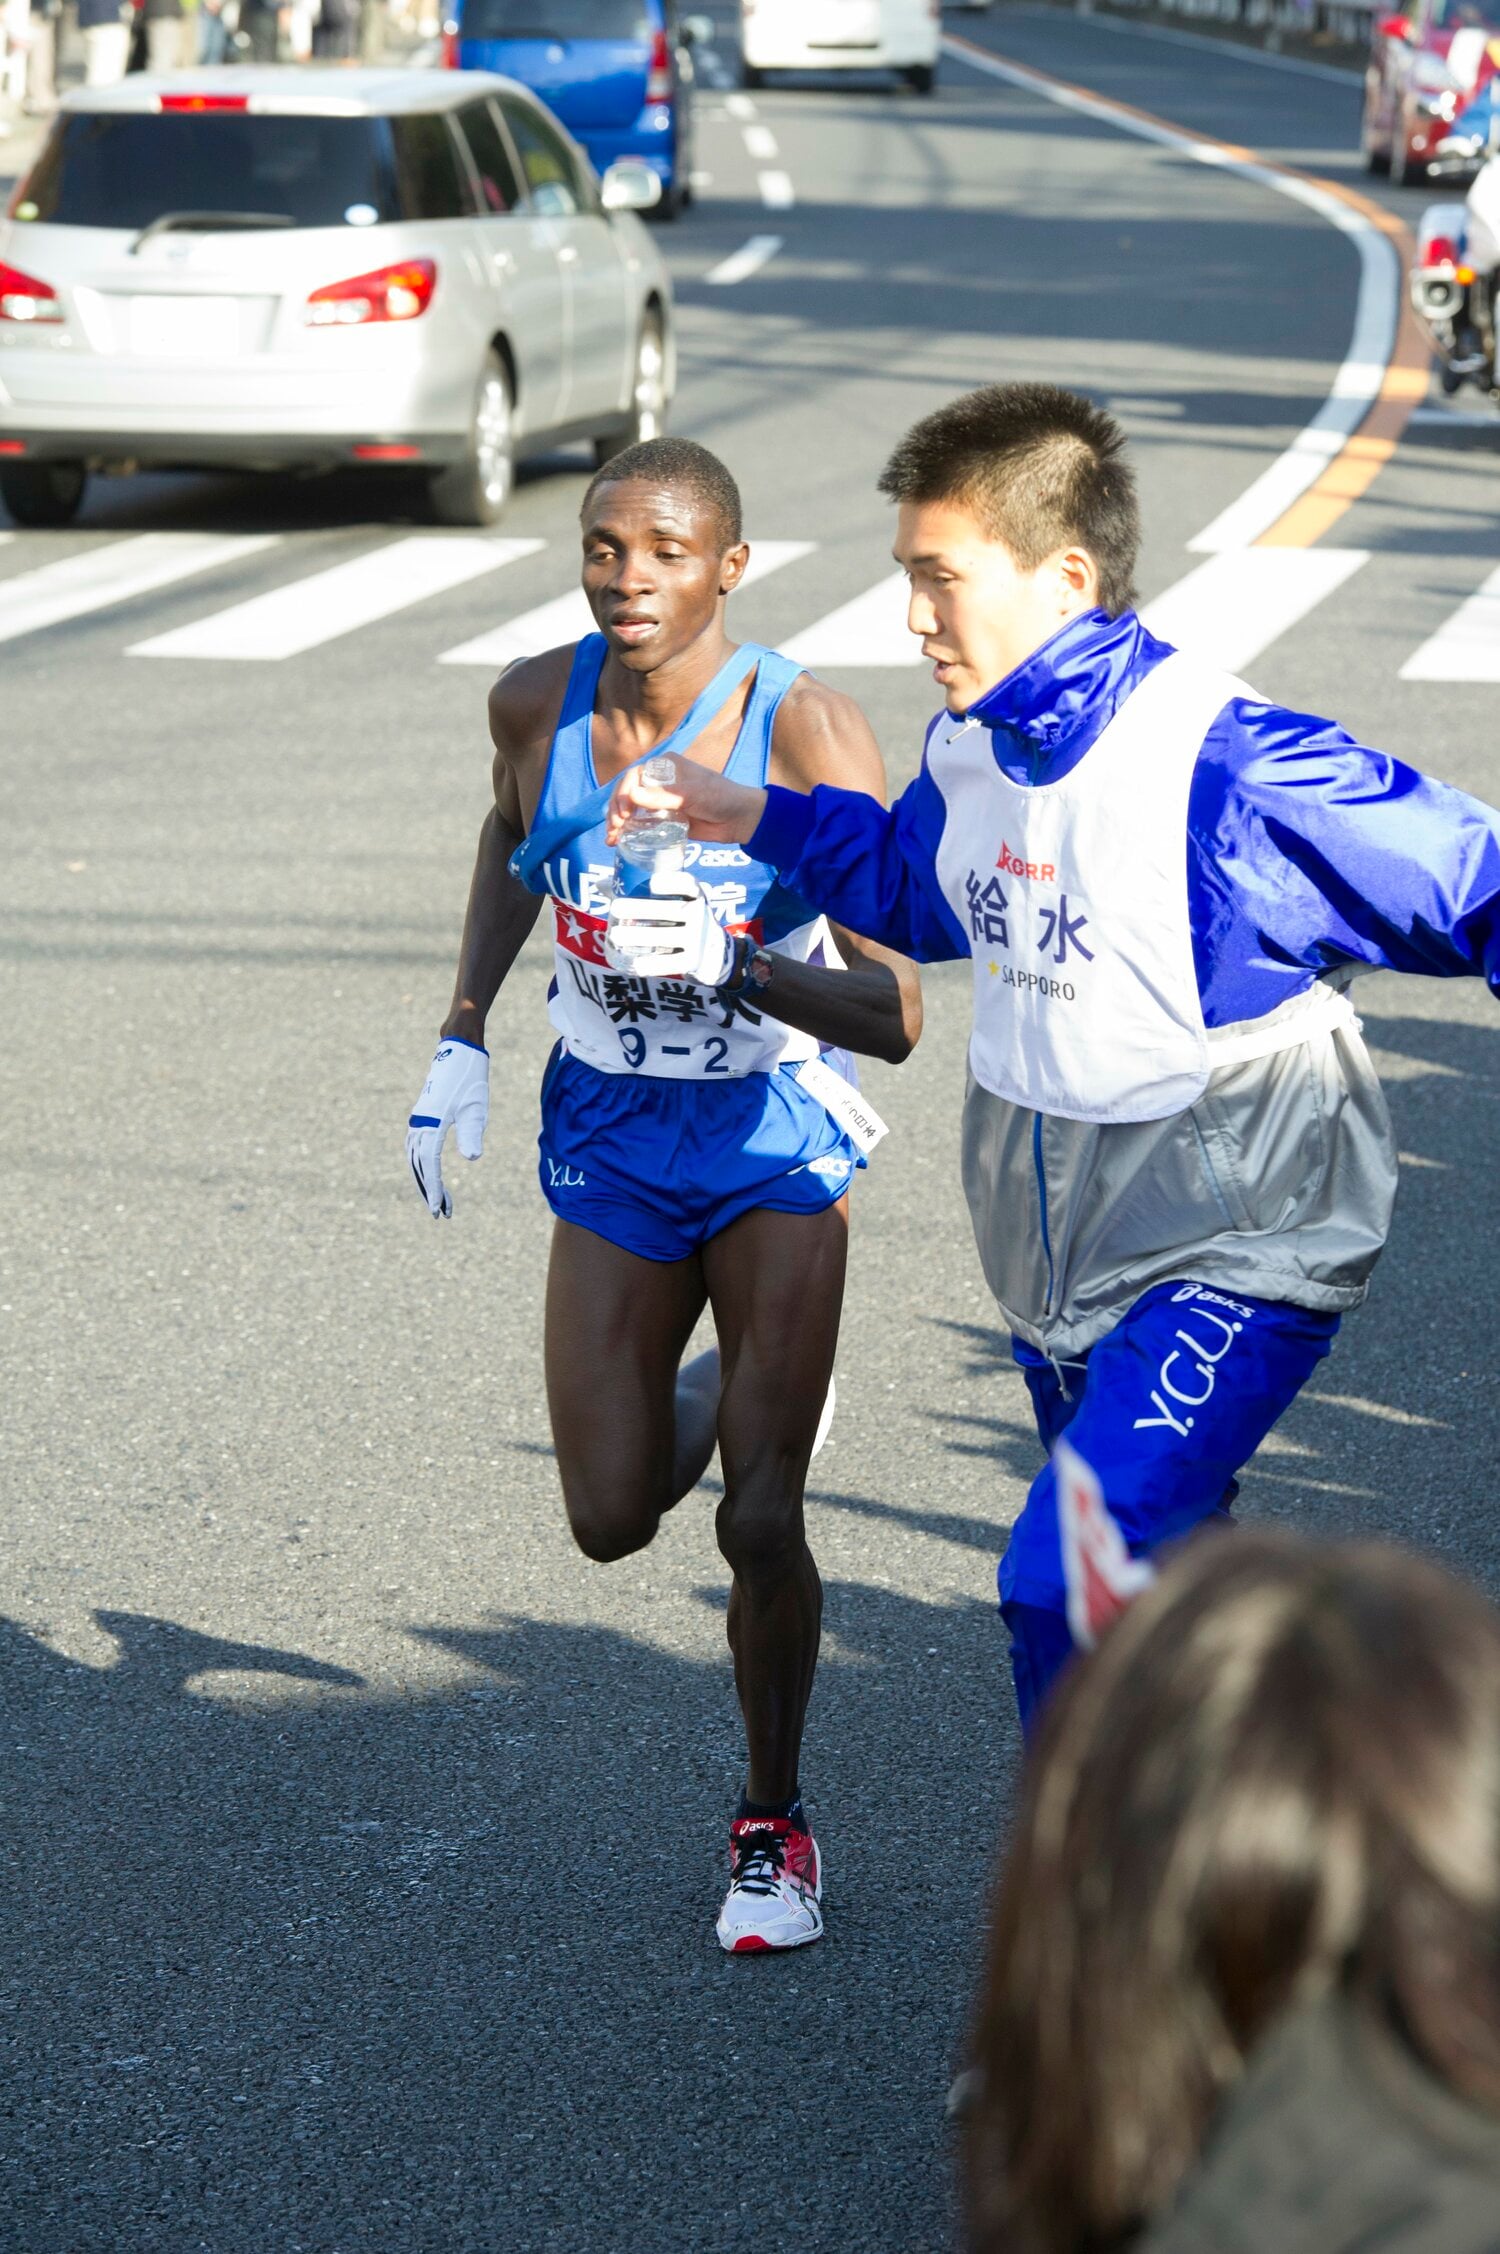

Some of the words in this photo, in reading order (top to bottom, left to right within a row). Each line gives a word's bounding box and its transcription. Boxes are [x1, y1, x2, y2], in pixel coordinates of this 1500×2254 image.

[698, 849, 752, 867] asics
[1002, 964, 1076, 1001] SAPPORO
[1196, 1290, 1256, 1318] asics
[749, 1821, 774, 1832] asics
